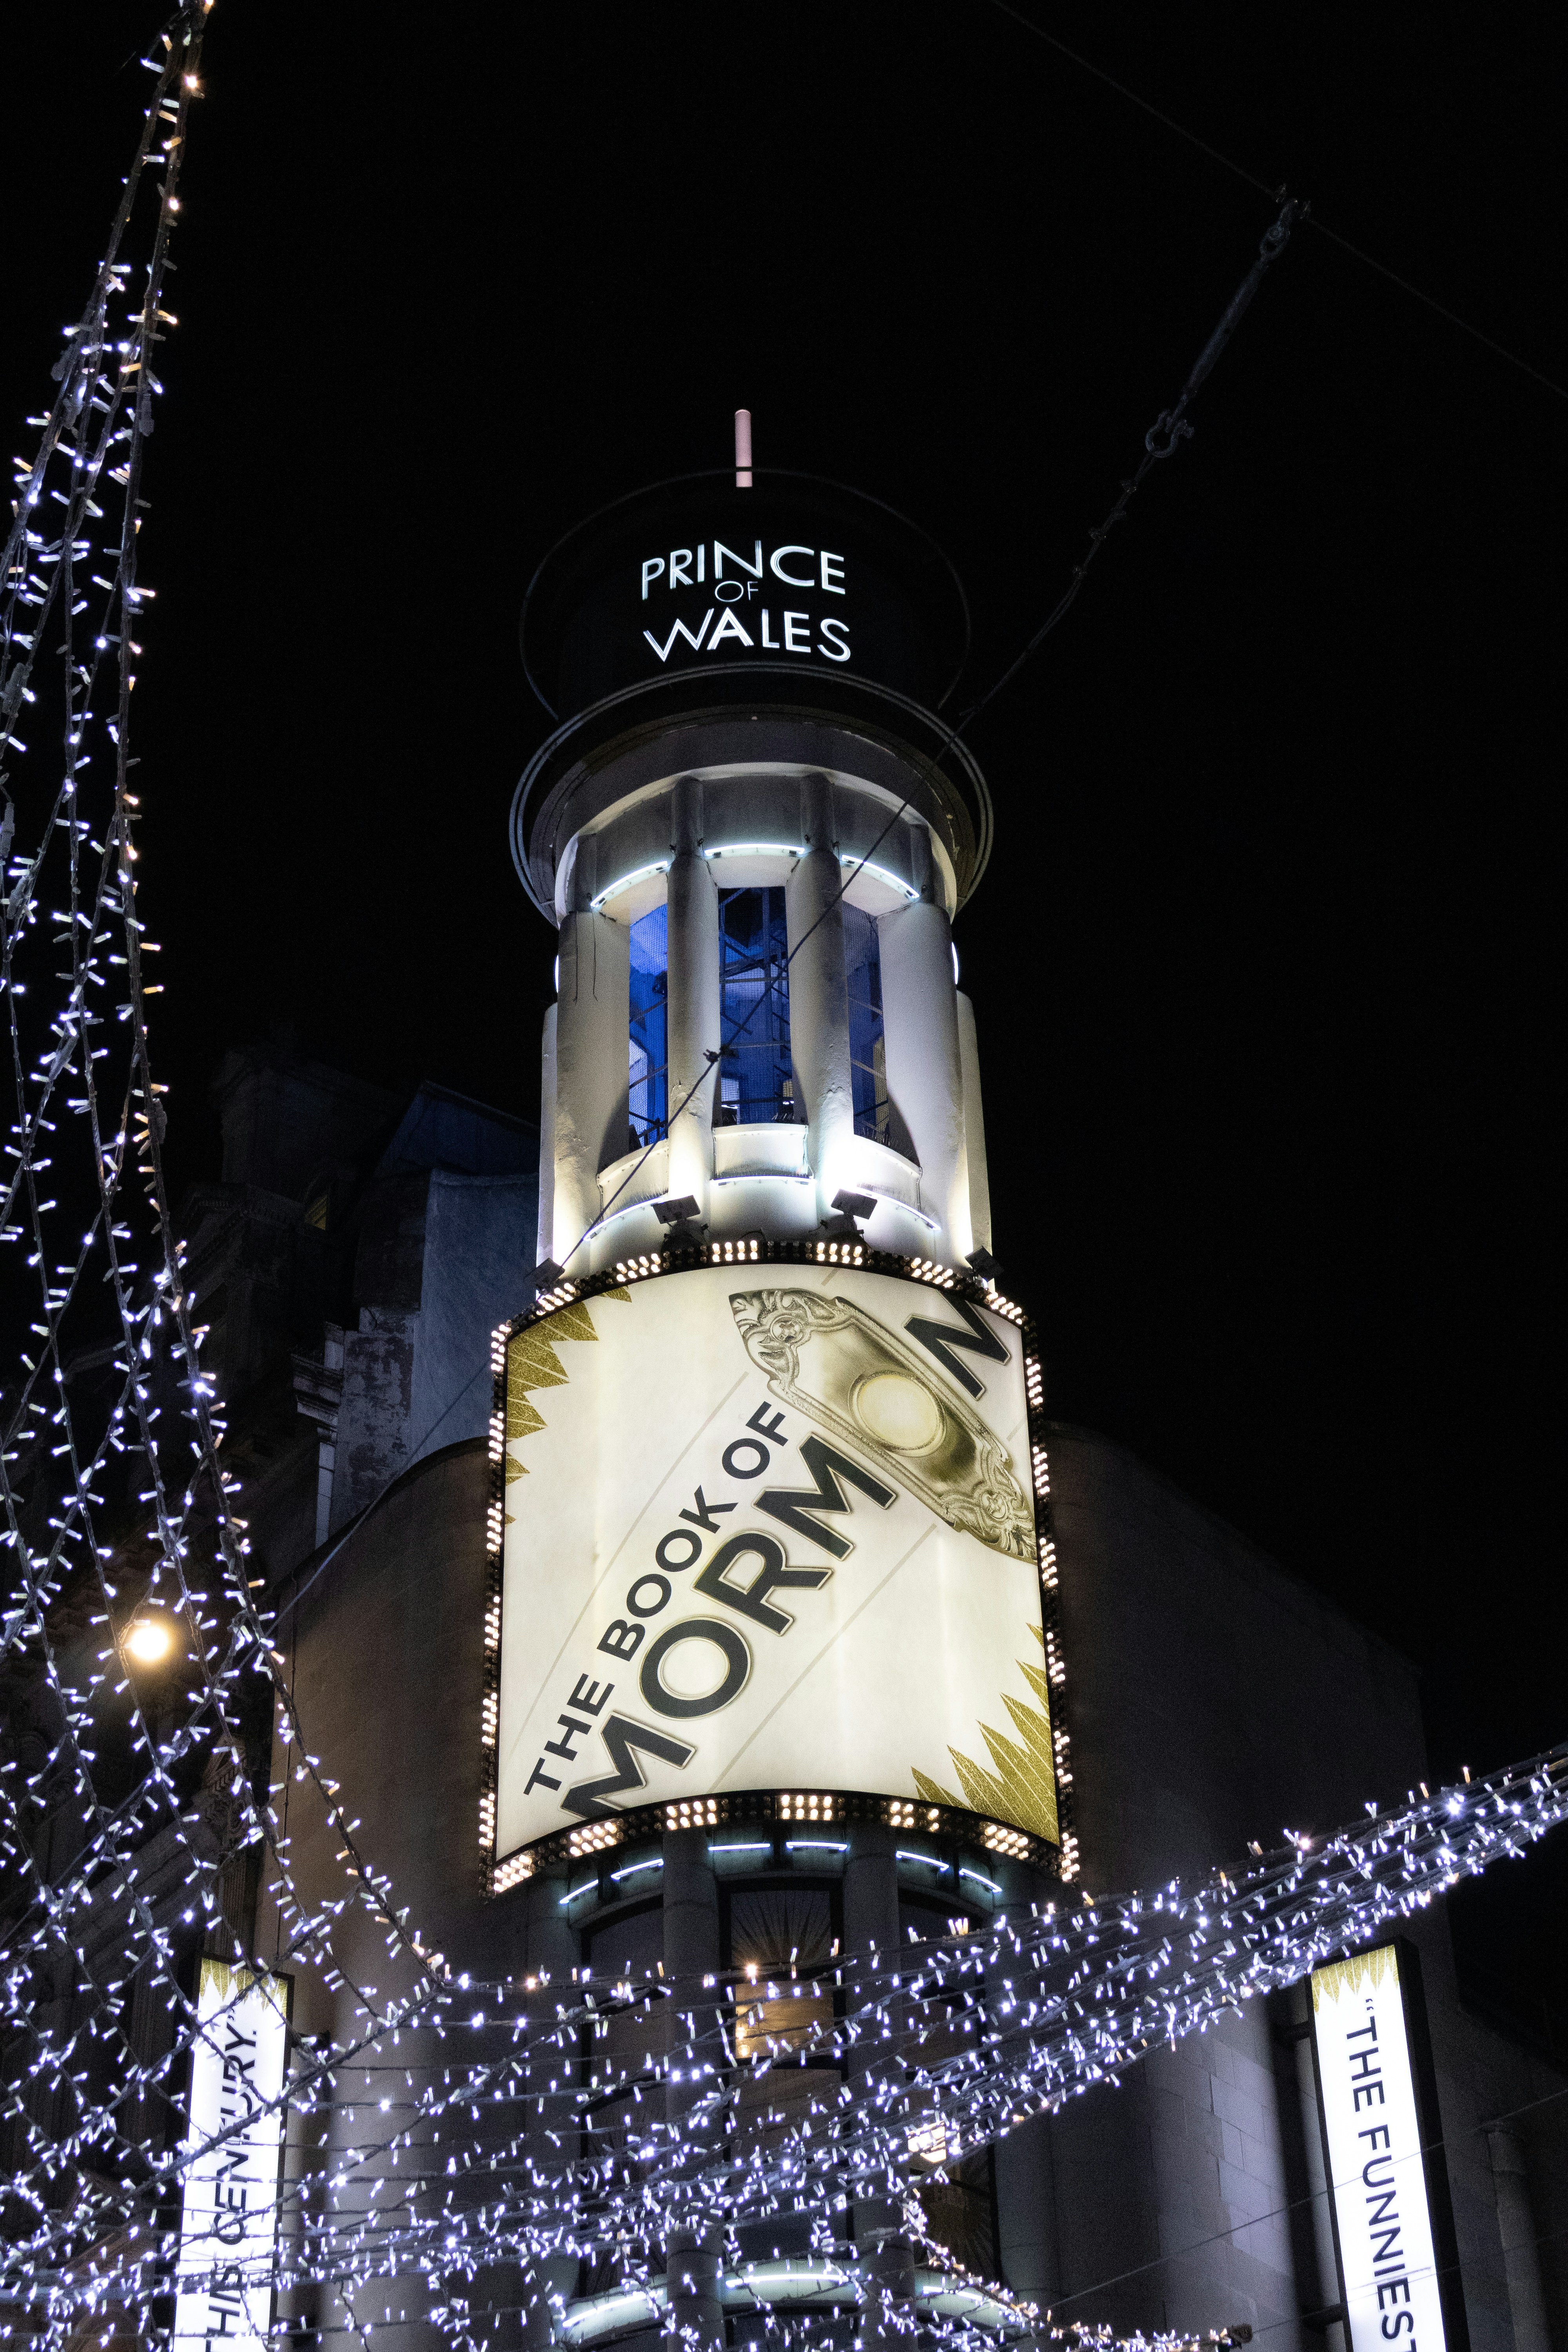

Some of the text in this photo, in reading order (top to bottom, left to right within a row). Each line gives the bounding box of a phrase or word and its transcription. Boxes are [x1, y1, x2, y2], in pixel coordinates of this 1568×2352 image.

[642, 540, 846, 600] PRINCE
[714, 580, 759, 602] OF
[642, 607, 851, 662] WALES
[524, 1401, 788, 1796] THE BOOK OF
